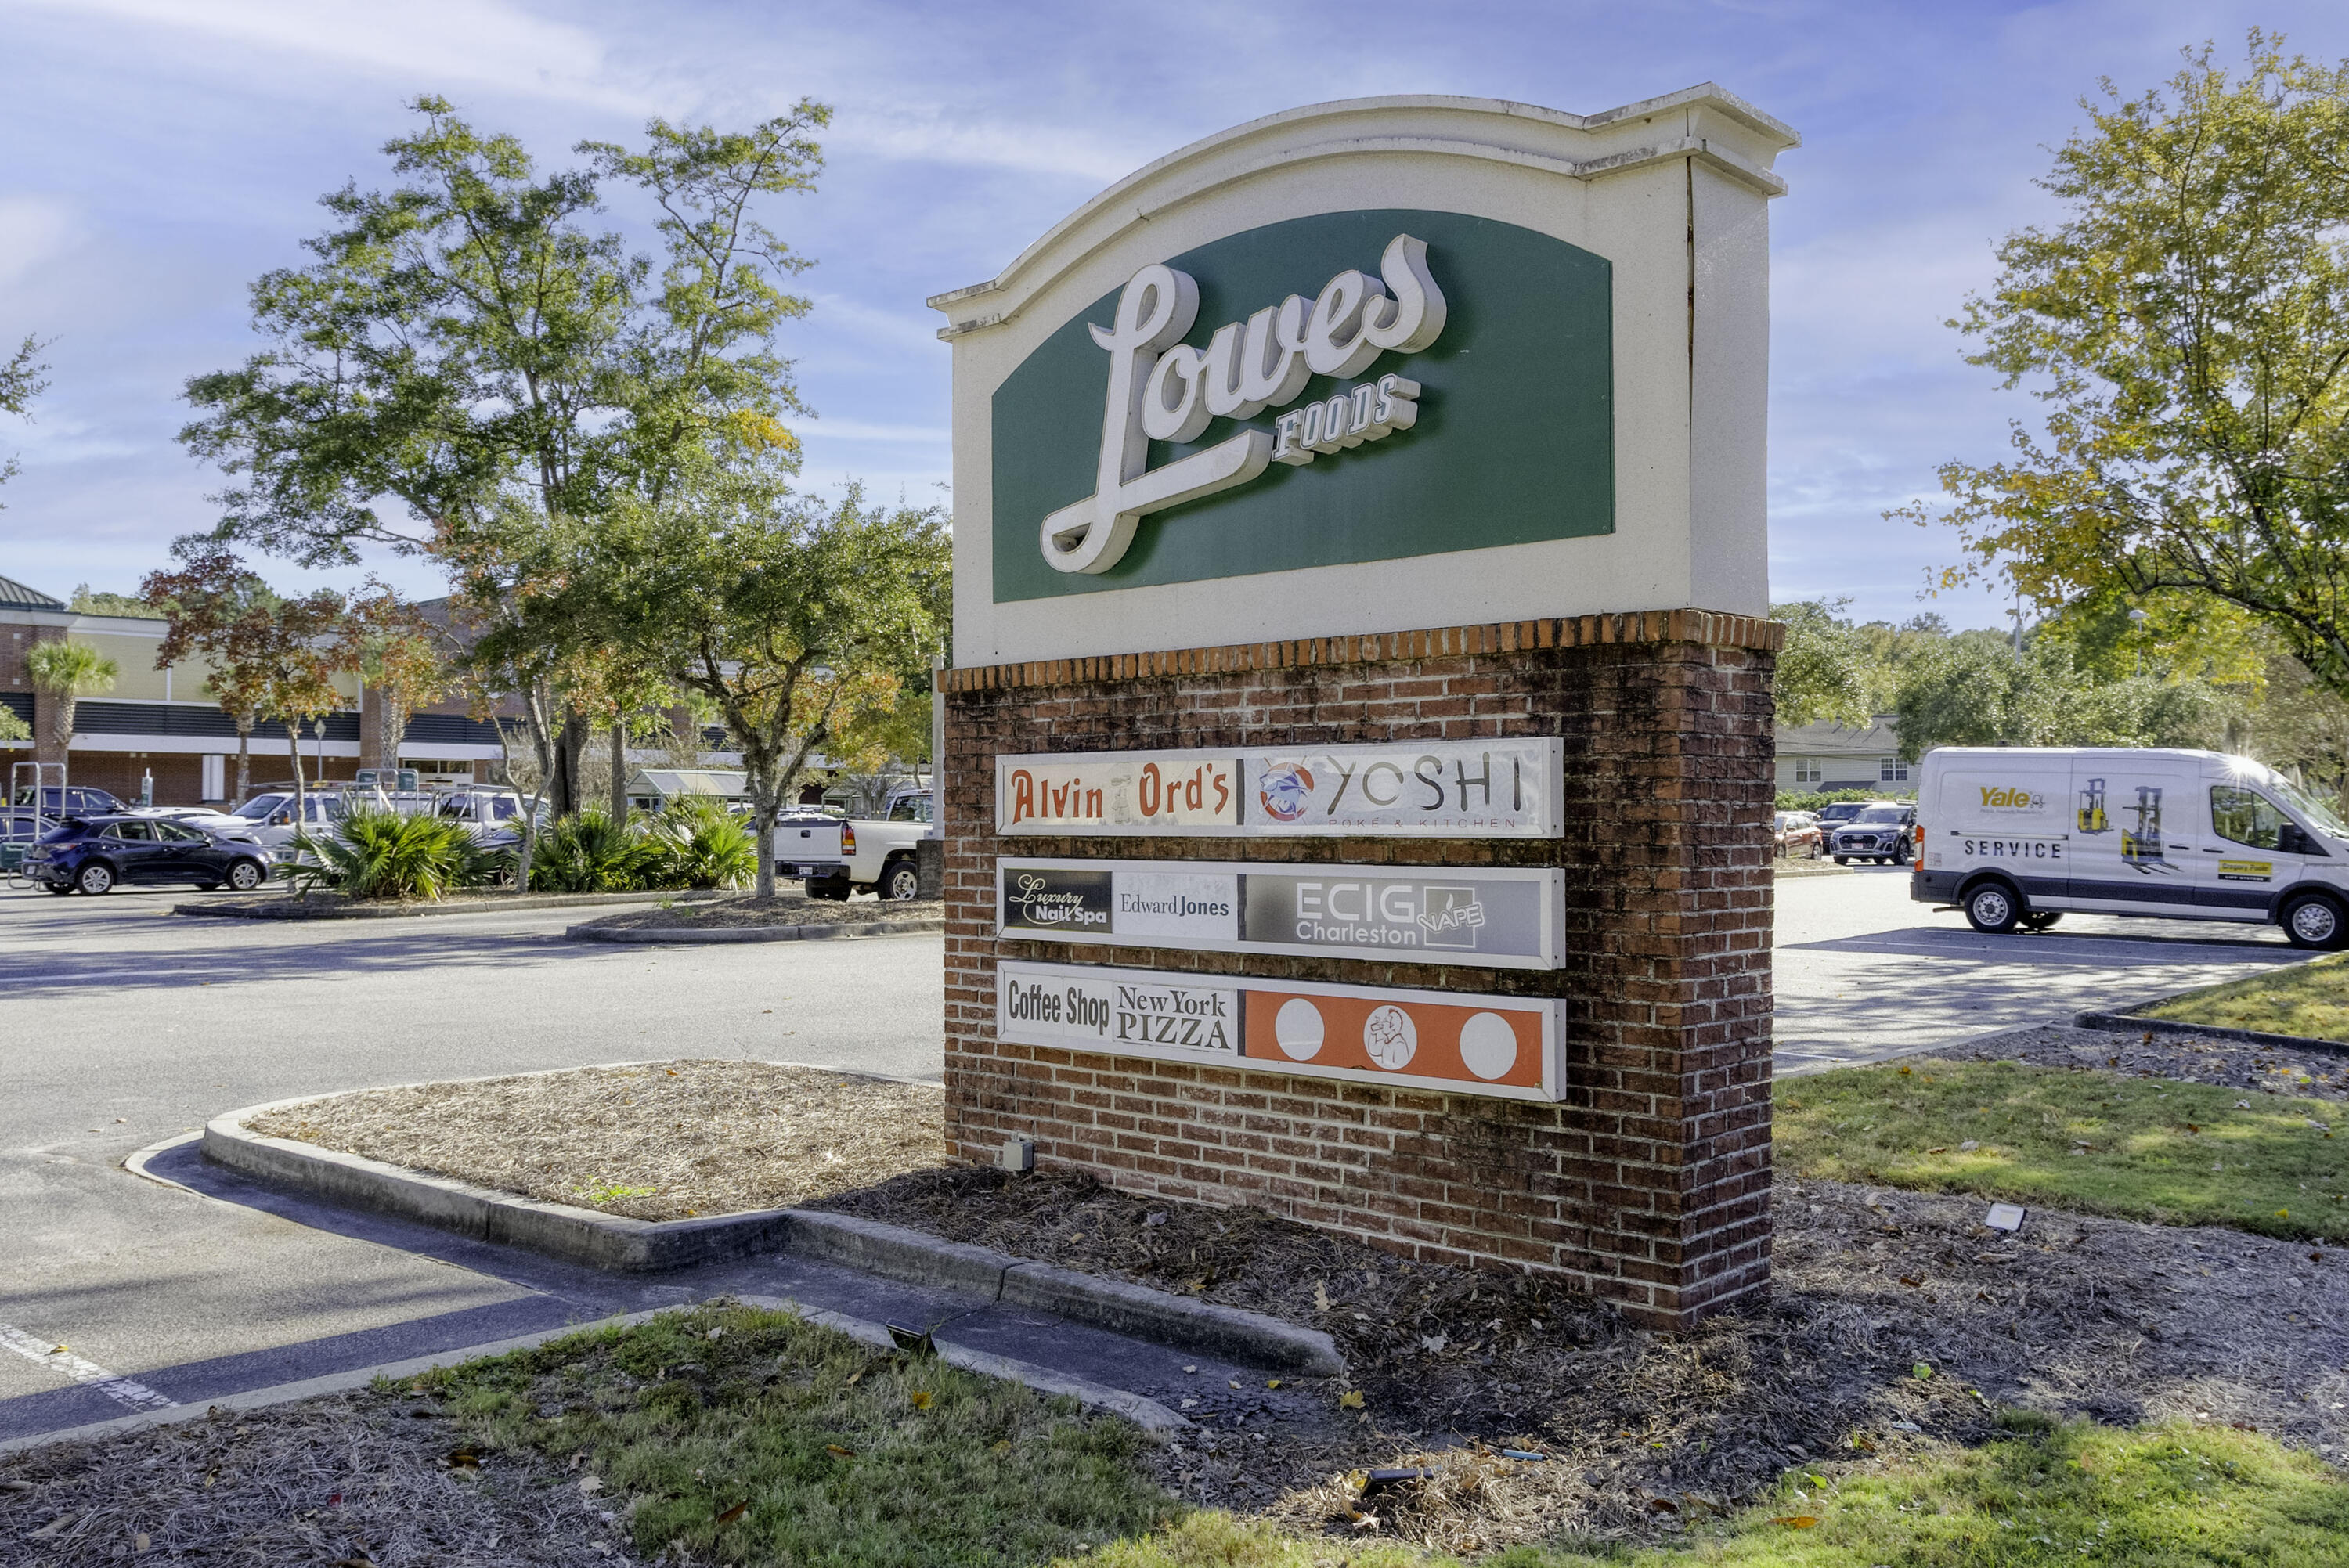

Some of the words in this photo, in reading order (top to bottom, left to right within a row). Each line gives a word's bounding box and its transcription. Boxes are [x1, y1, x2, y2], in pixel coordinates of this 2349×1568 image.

[1040, 233, 1446, 574] Lowes
[1272, 373, 1421, 466] FOODS
[1011, 769, 1103, 824] Alvin
[1139, 762, 1229, 816] Ord's
[1326, 751, 1521, 815] YOSHI
[1979, 787, 2030, 808] Yale
[1328, 817, 1380, 828] POKÉ
[1394, 819, 1404, 828] &
[1419, 819, 1516, 828] KITCHEN
[1965, 840, 2061, 859] SERVICE
[1009, 874, 1084, 925] Luxury
[1035, 904, 1071, 922] Nail
[1074, 907, 1107, 925] Spa
[1296, 882, 1416, 924] ECIG
[1417, 902, 1485, 934] VAPE
[1296, 921, 1416, 946] Charleston
[1009, 980, 1061, 1023] Coffee
[1066, 987, 1110, 1036] Shop
[1117, 986, 1168, 1012] New
[1170, 989, 1226, 1018] York
[1117, 1011, 1232, 1050] PIZZA
